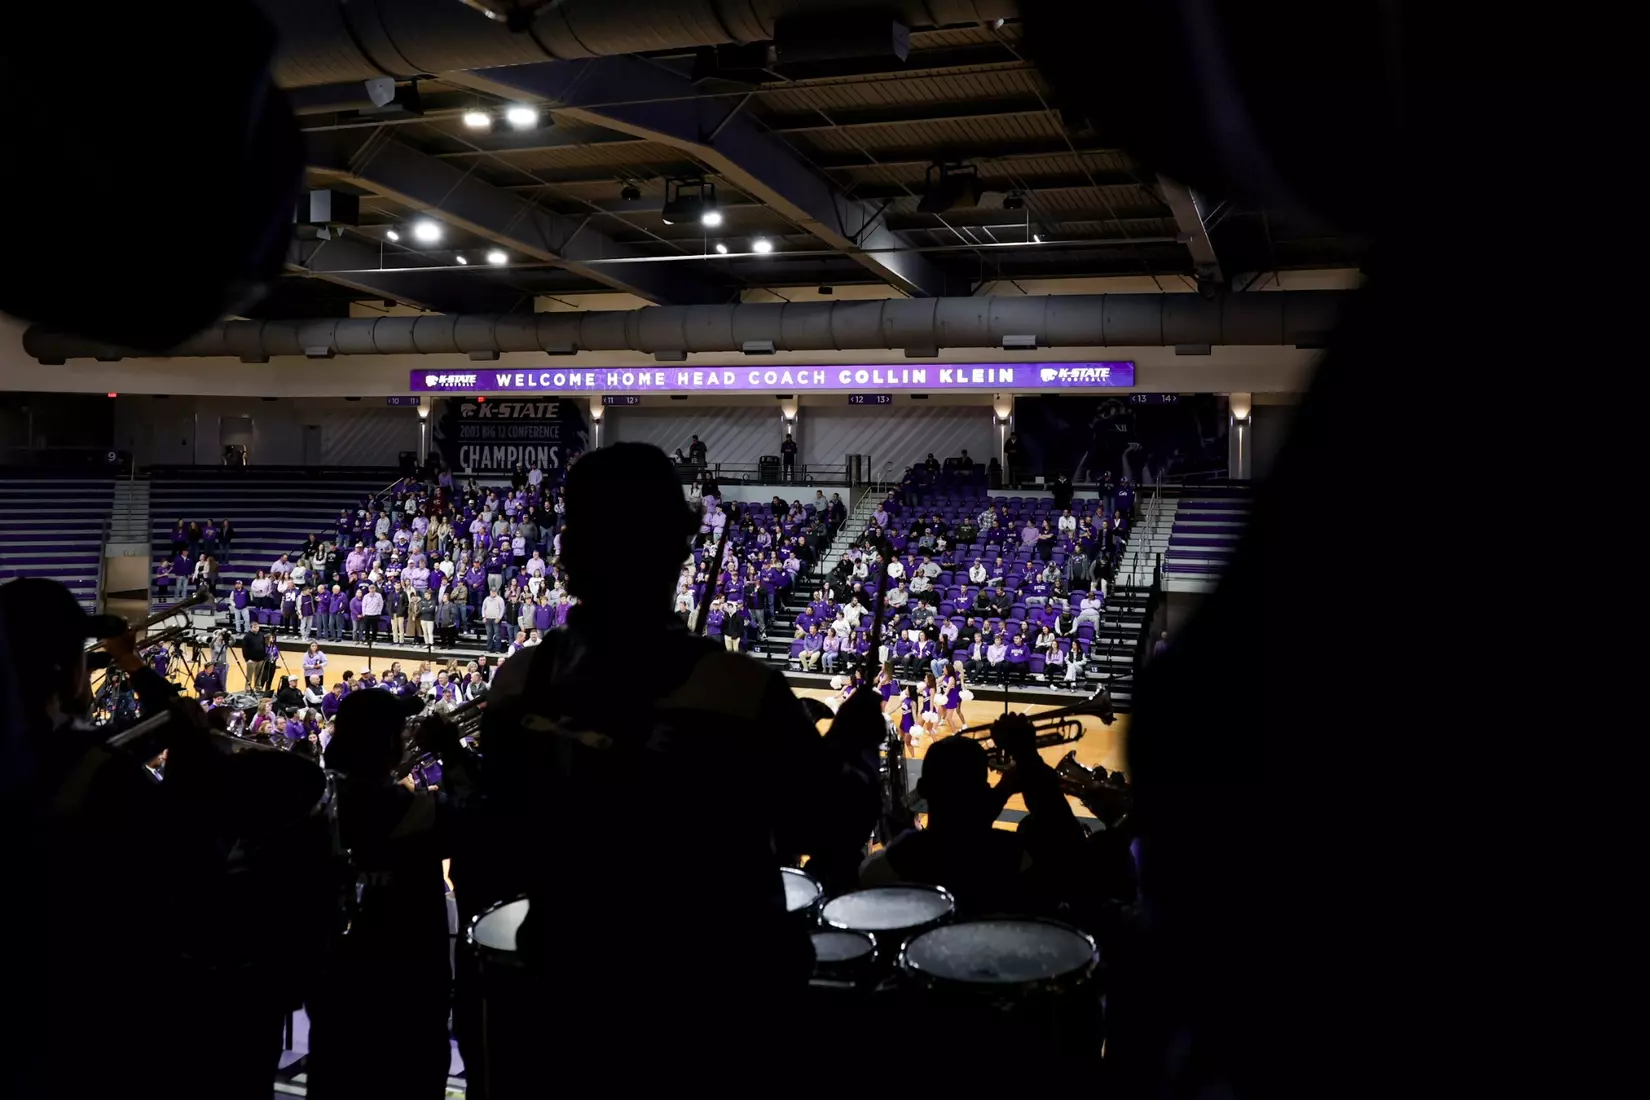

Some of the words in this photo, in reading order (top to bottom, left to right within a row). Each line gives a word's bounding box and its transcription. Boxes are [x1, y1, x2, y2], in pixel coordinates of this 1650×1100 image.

[496, 373, 596, 387] WELCOME
[607, 372, 665, 386] HOME
[678, 371, 736, 385] HEAD
[748, 370, 825, 385] COACH
[839, 369, 927, 384] COLLIN
[939, 368, 1014, 383] KLEIN
[1058, 367, 1111, 378] K-STATE
[438, 374, 477, 384] K-STATE
[392, 397, 400, 405] 10
[607, 396, 614, 404] 11
[626, 396, 635, 404] 12
[855, 395, 864, 404] 12
[876, 395, 886, 404] 13
[1137, 394, 1147, 403] 13
[1161, 394, 1171, 403] 14
[478, 402, 560, 418] K-STATE
[460, 425, 480, 438] 2003
[481, 425, 497, 438] BIG
[498, 425, 507, 438] 12
[507, 425, 560, 438] CONFERENCE
[107, 451, 117, 461] 9
[459, 445, 559, 469] CHAMPIONS
[285, 592, 296, 602] 24
